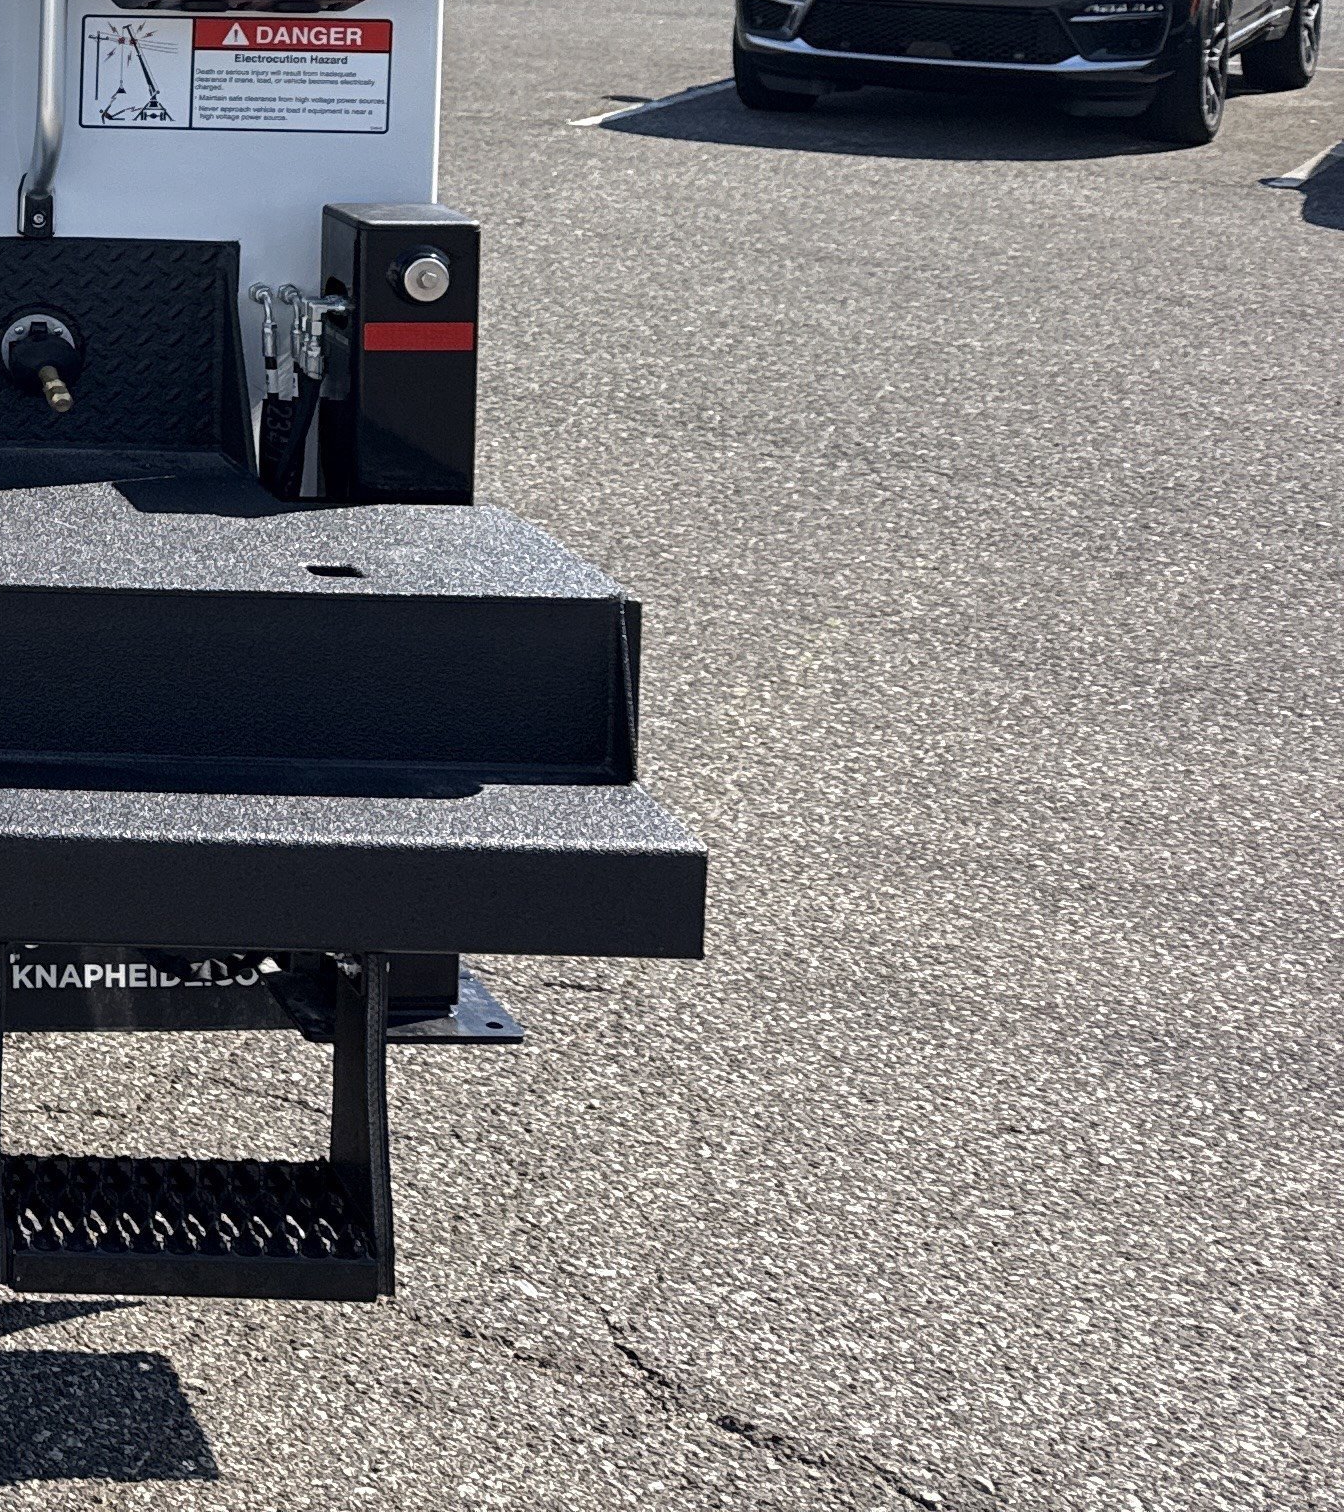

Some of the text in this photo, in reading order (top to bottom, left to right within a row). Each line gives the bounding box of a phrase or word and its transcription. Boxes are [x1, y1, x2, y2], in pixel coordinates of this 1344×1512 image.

[255, 25, 363, 47] DANGER
[234, 53, 348, 65] Electrocution Hazard
